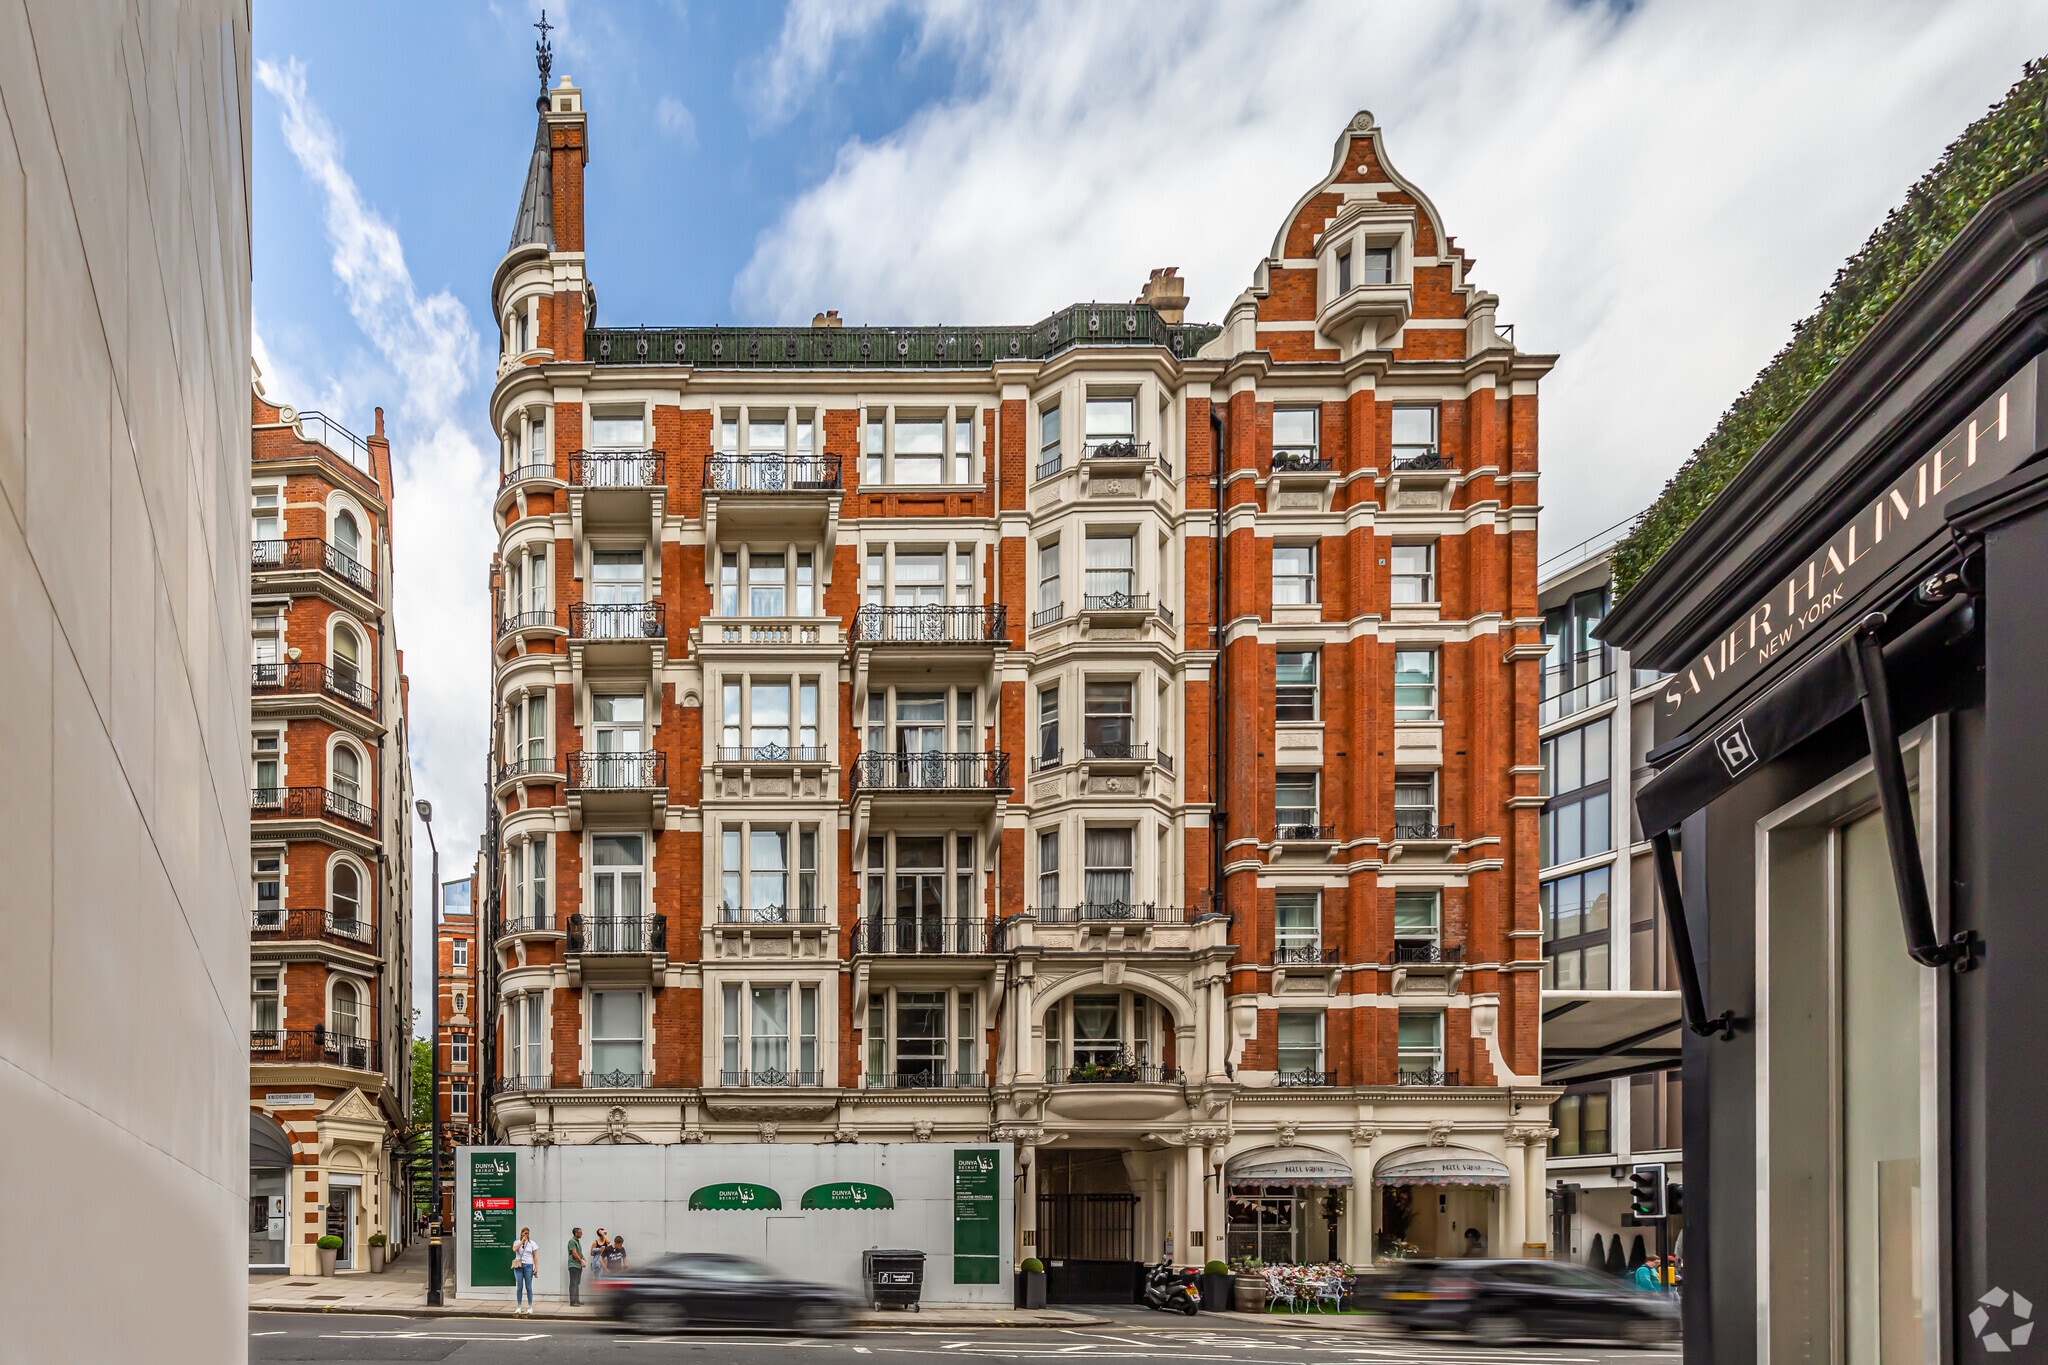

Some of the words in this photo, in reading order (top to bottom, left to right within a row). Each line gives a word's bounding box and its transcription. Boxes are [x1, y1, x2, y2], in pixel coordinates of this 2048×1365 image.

[1664, 602, 1773, 718] SAMER
[1787, 391, 2008, 617] HALIMEH
[1758, 627, 1794, 665] NEW
[1797, 583, 1844, 629] YORK
[392, 1123, 433, 1138] PARK
